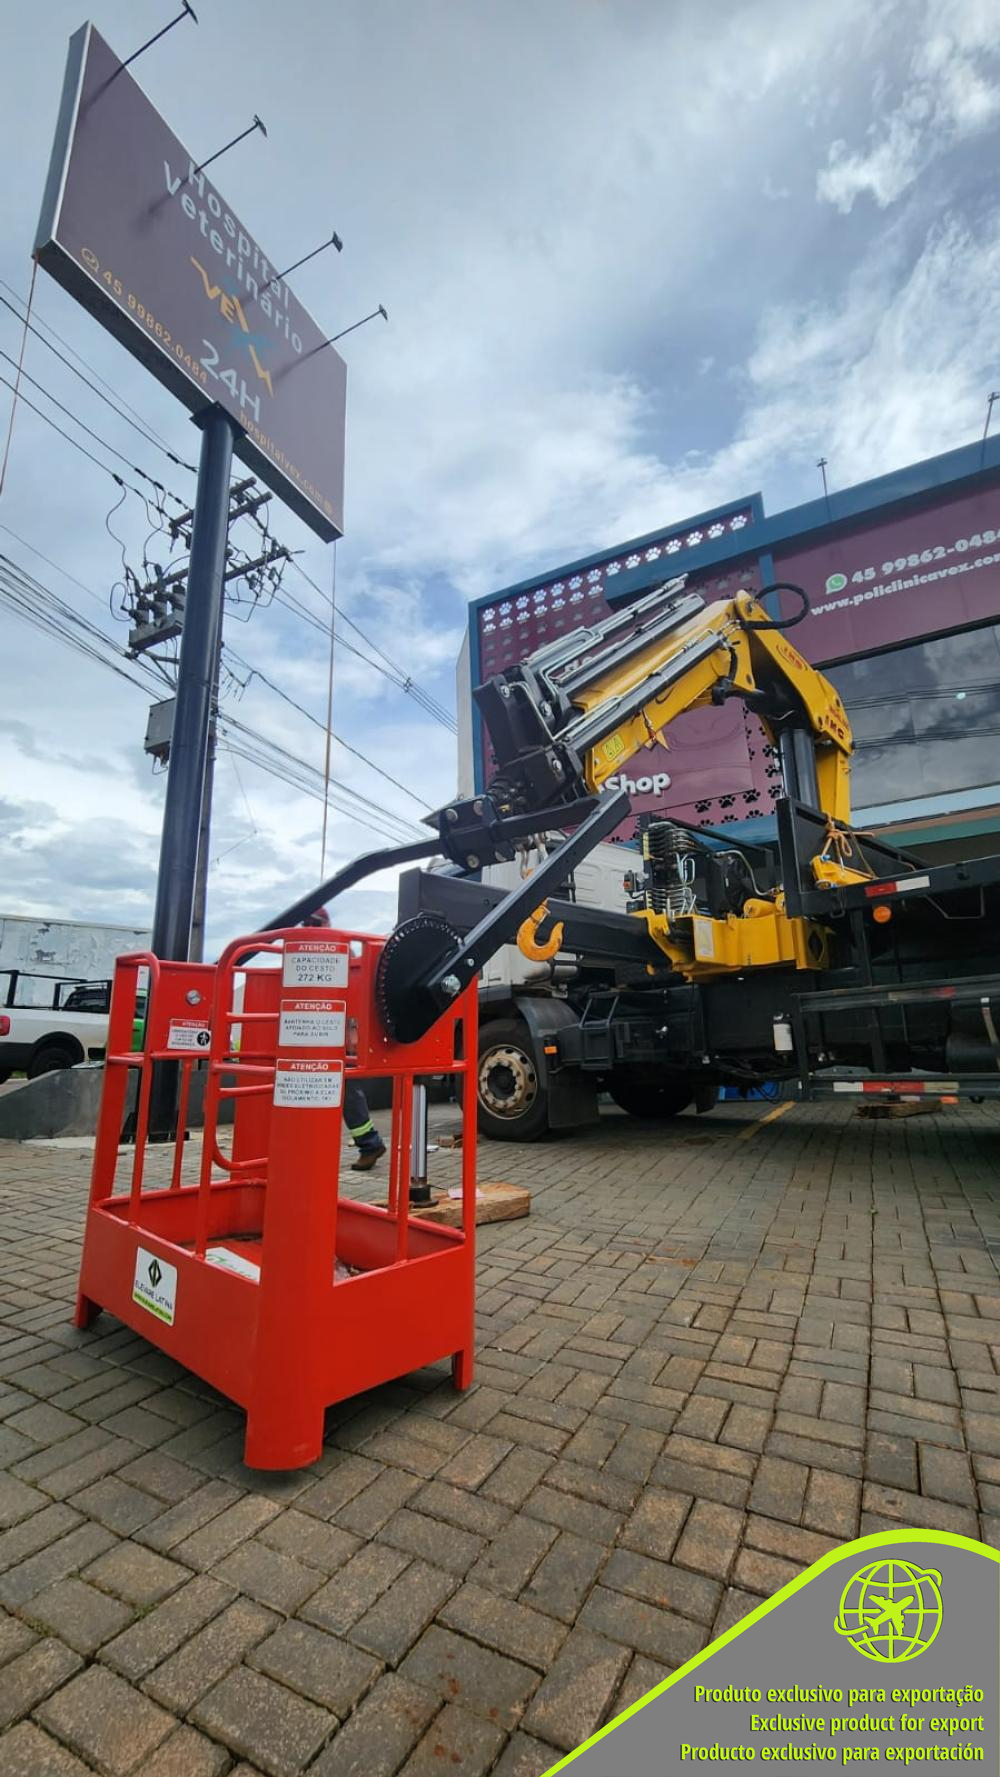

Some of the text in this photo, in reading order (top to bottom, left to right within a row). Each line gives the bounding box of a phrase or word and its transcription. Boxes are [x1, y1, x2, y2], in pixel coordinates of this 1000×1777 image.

[188, 161, 289, 309] Hospital
[163, 160, 302, 353] Veterinário
[102, 270, 122, 296] 45
[200, 339, 261, 423] 24H
[851, 528, 1000, 583] 45 99862-048
[298, 943, 337, 953] ATENÇÃO
[291, 956, 341, 965] CAPACIDADE
[296, 965, 336, 973] DO CESTO
[297, 973, 333, 982] 272 KG
[294, 1001, 333, 1012] ATENÇÃO
[290, 1062, 329, 1072] ATENÇÃO
